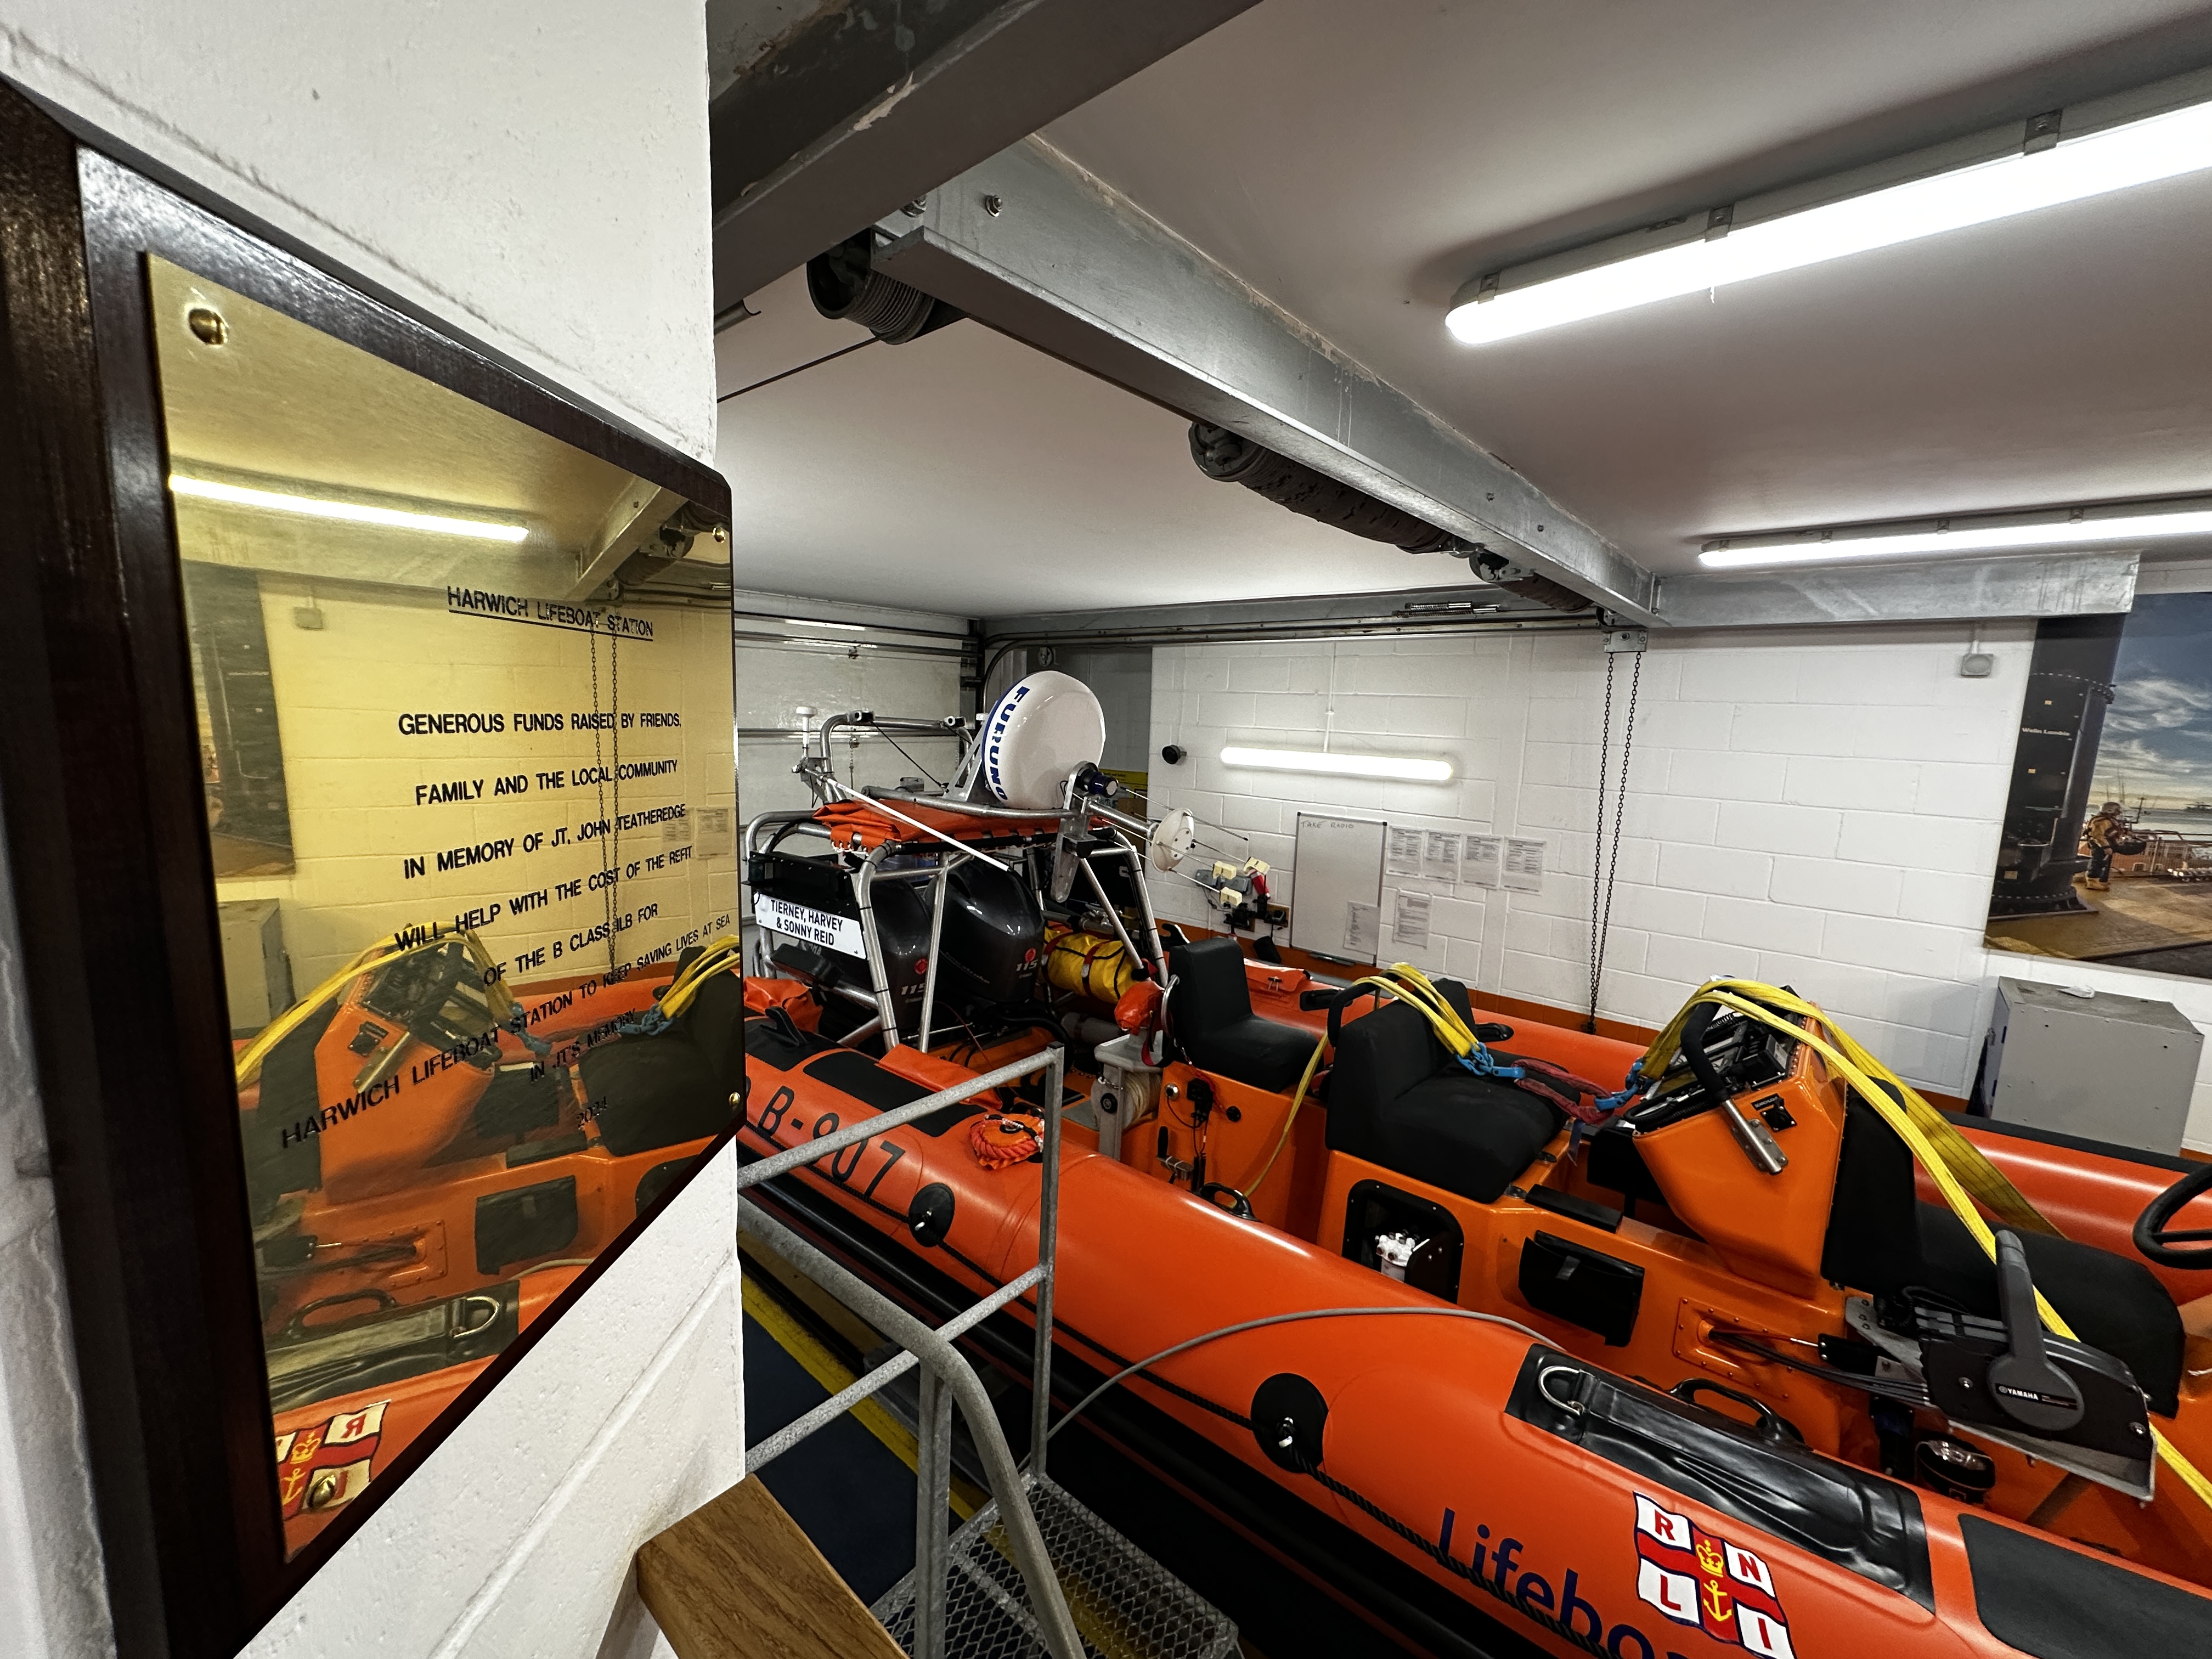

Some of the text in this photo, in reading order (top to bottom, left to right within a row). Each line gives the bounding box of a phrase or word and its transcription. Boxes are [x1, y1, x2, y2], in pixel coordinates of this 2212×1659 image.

[447, 585, 653, 637] HARWICH LIFEBOAT STATION
[398, 713, 505, 735] GENEROUS
[514, 713, 564, 732] FUNDS
[571, 713, 615, 730] RAISED
[622, 714, 634, 729] BY
[989, 686, 1030, 800] FURUNO
[415, 759, 678, 805] FAMILY AND THE LOCAL COMMUNITY
[1301, 820, 1327, 828] TAKE
[404, 855, 425, 879] IN
[437, 838, 514, 872] MEMORY
[523, 832, 543, 853] OF
[577, 819, 611, 841] JOHN
[394, 846, 692, 951] WILL HELP WITH THE COST OF THE REFIT
[771, 899, 843, 932] TIERNEY, HARVEY
[483, 902, 658, 986] OF THE B CLASS ILB FOR
[776, 917, 834, 946] & SONNY REID
[1015, 959, 1039, 972] 115
[281, 914, 730, 1149] HARWICH LIFEBOAT STATION TO KEEP SAVING LIVES AT SEA
[530, 1060, 545, 1084] IN
[552, 1041, 580, 1069] JT'S
[2007, 1388, 2039, 1400] YAMAHA
[1654, 1509, 1675, 1541] R
[1437, 1507, 1691, 1659] Lifebo
